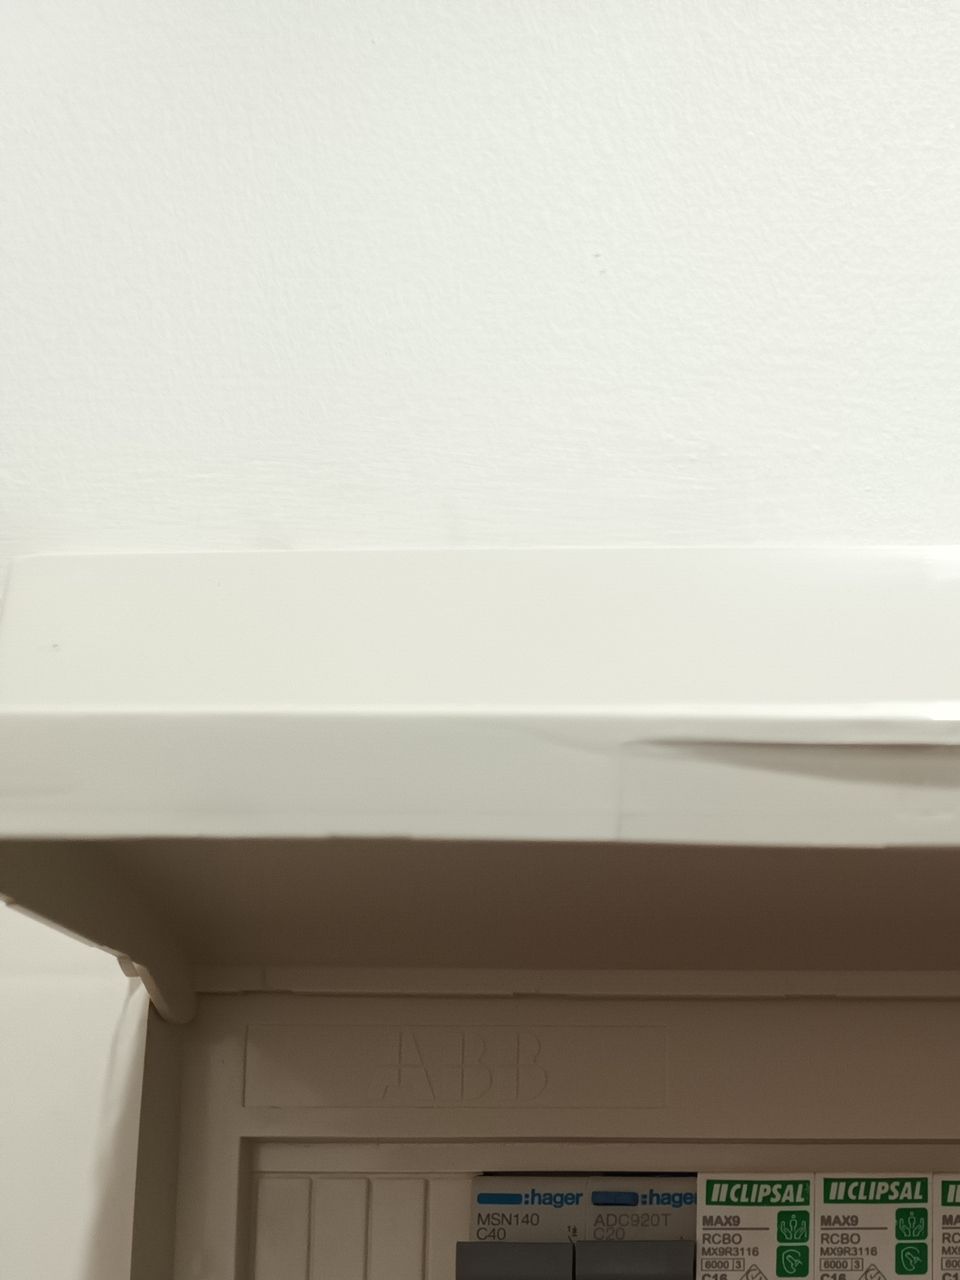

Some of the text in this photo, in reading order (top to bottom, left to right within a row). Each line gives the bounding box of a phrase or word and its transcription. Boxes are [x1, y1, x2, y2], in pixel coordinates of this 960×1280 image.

[382, 1032, 548, 1100] ABB
[477, 1213, 540, 1226] MSN140
[593, 1213, 671, 1227] ADC920T
[703, 1215, 741, 1227] MAX9
[820, 1215, 859, 1226] MAX9
[477, 1228, 506, 1240] C40
[593, 1228, 625, 1240] C20
[702, 1233, 742, 1245] RCBO
[820, 1233, 861, 1244] RCBO
[701, 1247, 759, 1256] MX9R3116
[820, 1247, 878, 1256] MX9R3116
[705, 1260, 730, 1269] 6000
[823, 1260, 848, 1269] 6000
